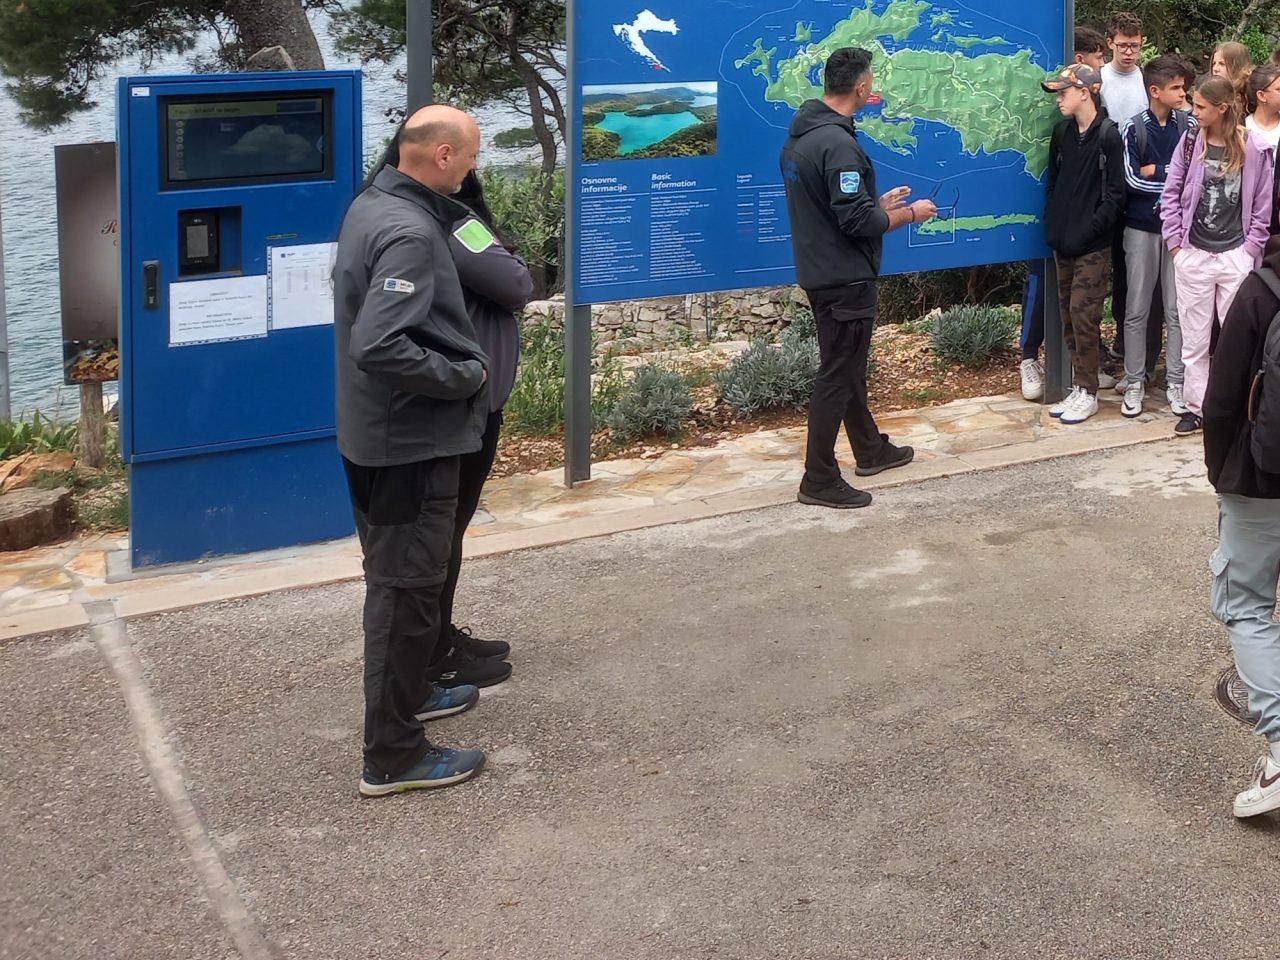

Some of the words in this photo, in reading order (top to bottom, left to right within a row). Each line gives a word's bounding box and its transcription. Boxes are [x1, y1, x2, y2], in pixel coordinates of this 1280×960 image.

[581, 177, 617, 185] Osnovne
[651, 172, 672, 181] Basic
[581, 184, 628, 193] informacije
[651, 180, 696, 190] information
